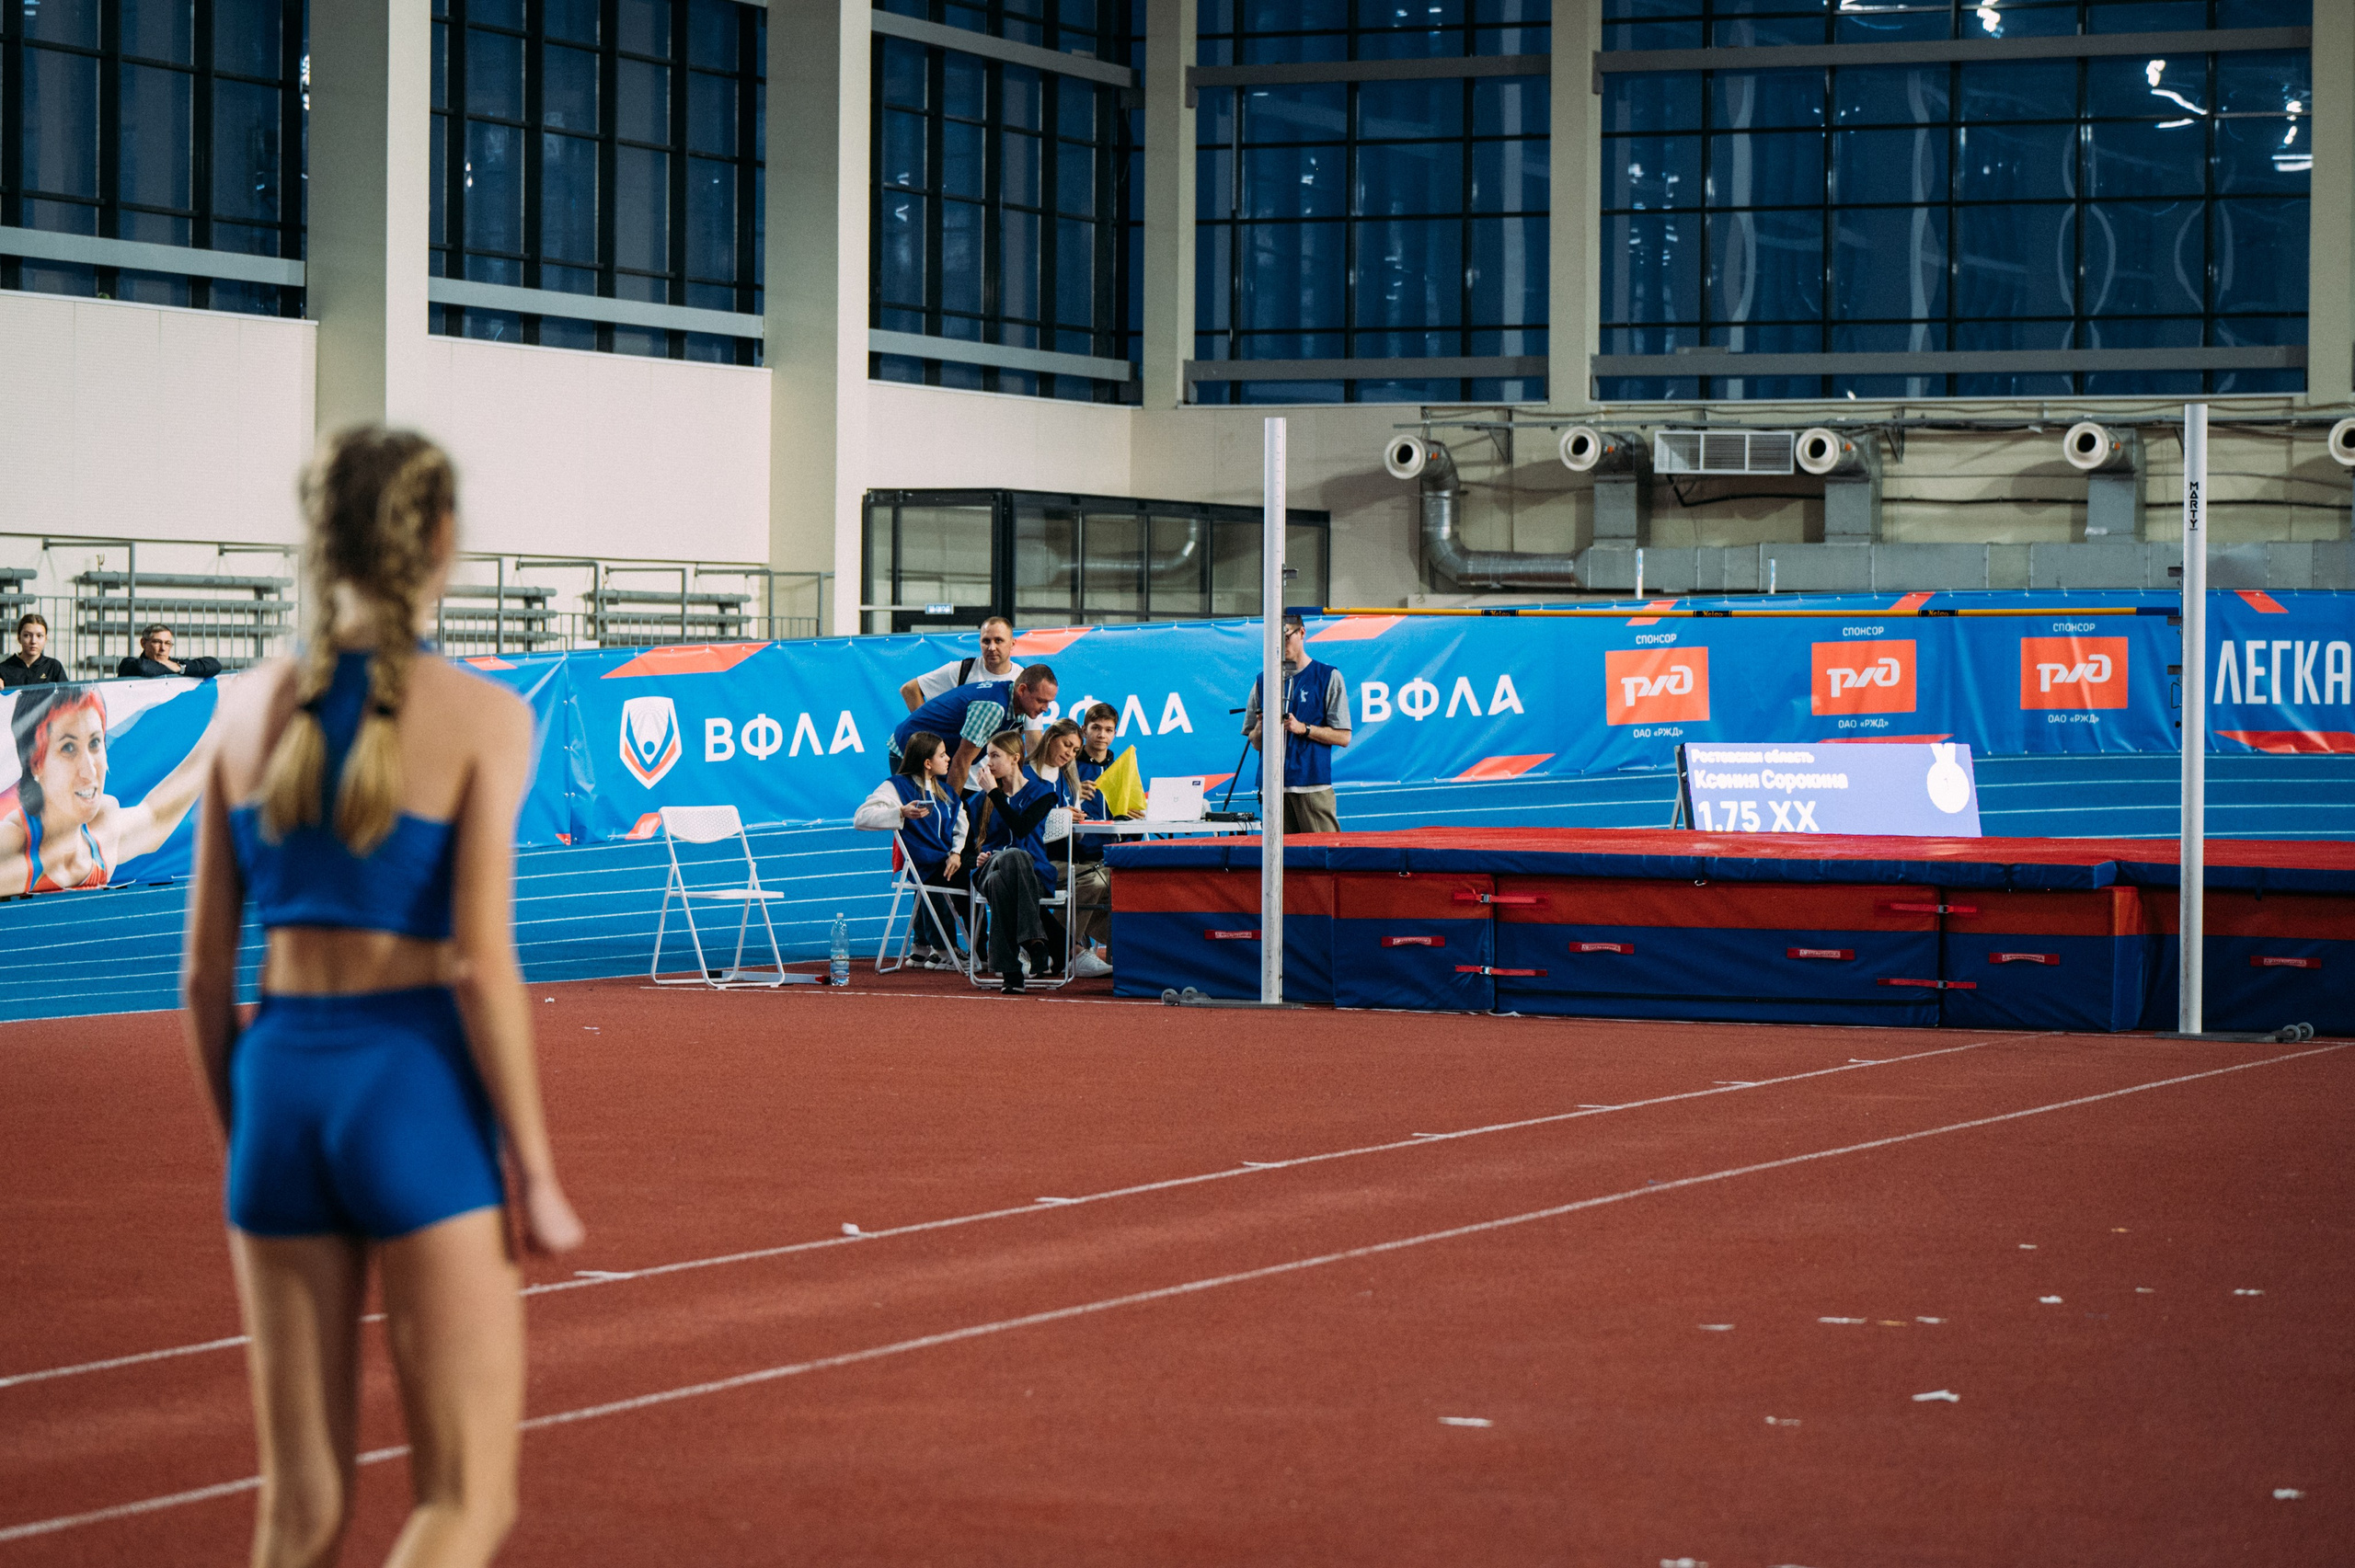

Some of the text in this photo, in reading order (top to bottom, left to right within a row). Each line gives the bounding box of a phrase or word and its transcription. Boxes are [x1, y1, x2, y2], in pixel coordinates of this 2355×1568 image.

[2189, 481, 2199, 528] MARTY
[1843, 626, 1884, 636] СПОНСОР
[2052, 623, 2096, 632] СПОНСОР
[1636, 633, 1677, 645] СПОНСОР
[2213, 640, 2351, 704] ЛЕГКА
[1361, 674, 1524, 722] ВФЛА
[1838, 717, 1890, 728] ОАО «РЖД»
[2048, 713, 2100, 724] ОАО «РЖД»
[705, 710, 865, 761] ВФЛА
[1633, 727, 1683, 738] ОАО «РЖД»
[1691, 749, 1815, 763] Ростовская область
[1694, 769, 1849, 795] Ксения Сорокина
[1698, 800, 1762, 832] 1.75
